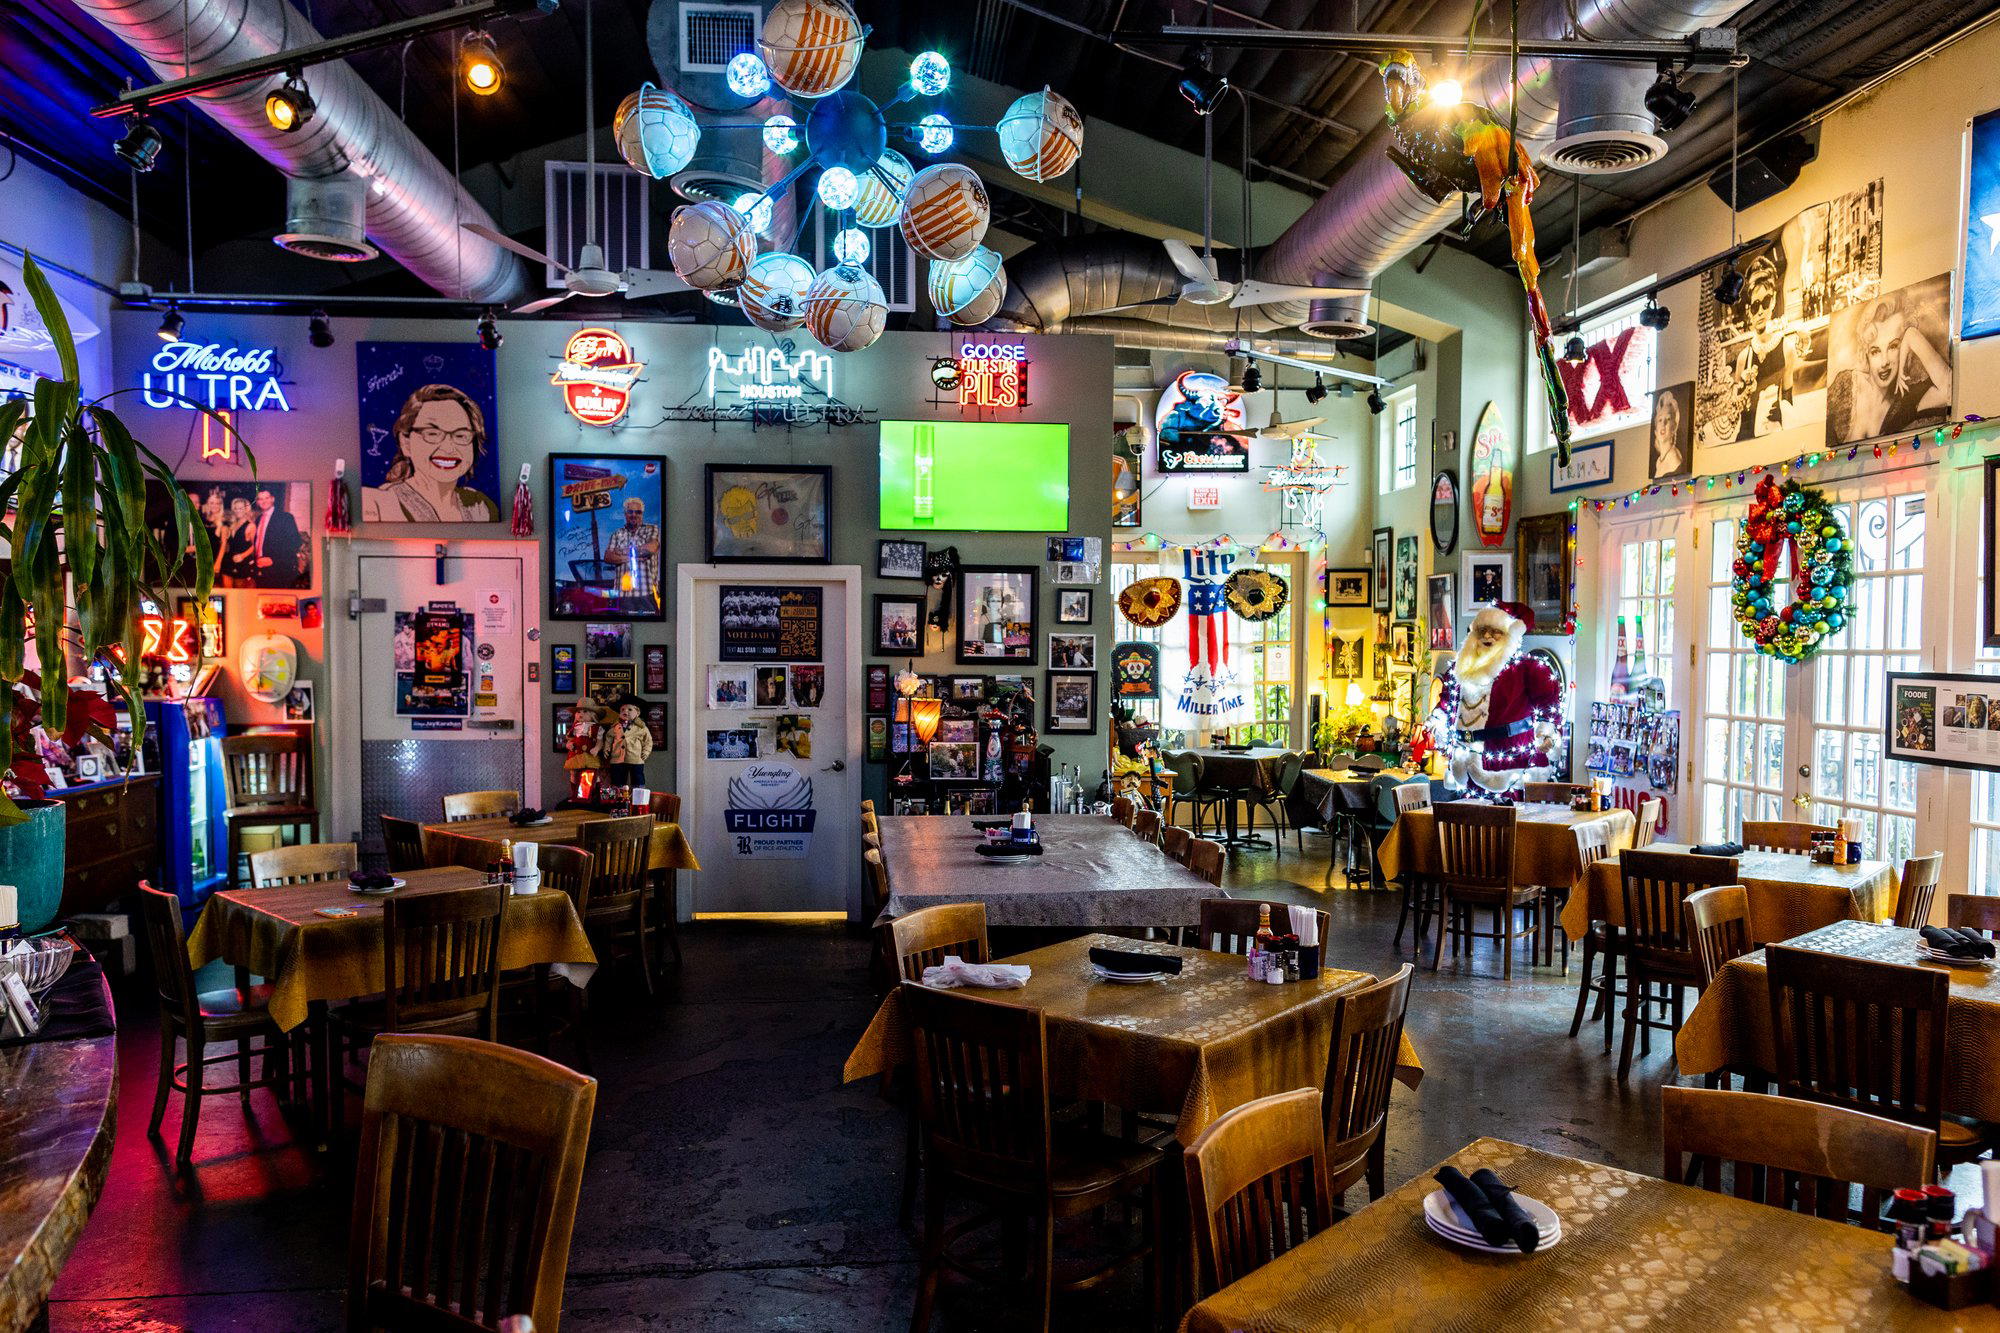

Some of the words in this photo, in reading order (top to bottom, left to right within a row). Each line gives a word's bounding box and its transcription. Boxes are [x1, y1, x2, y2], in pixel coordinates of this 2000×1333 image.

[961, 343, 1026, 361] GOOSE
[961, 359, 989, 373] FOUR
[990, 359, 1018, 374] STAR
[143, 372, 290, 412] ULTRA
[740, 385, 802, 400] HOUSTON
[960, 372, 1019, 407] PILS
[783, 403, 870, 424] ULTRA
[1195, 497, 1218, 505] EXIT
[1182, 548, 1236, 585] Lite
[727, 631, 750, 639] VOTE
[751, 631, 775, 639] DAILY
[1904, 690, 1928, 699] FOODIE
[1177, 695, 1218, 715] MILLER
[1219, 694, 1245, 714] TIME
[748, 766, 792, 779] Yuengling
[734, 814, 806, 828] FLIGHT
[736, 836, 752, 855] R
